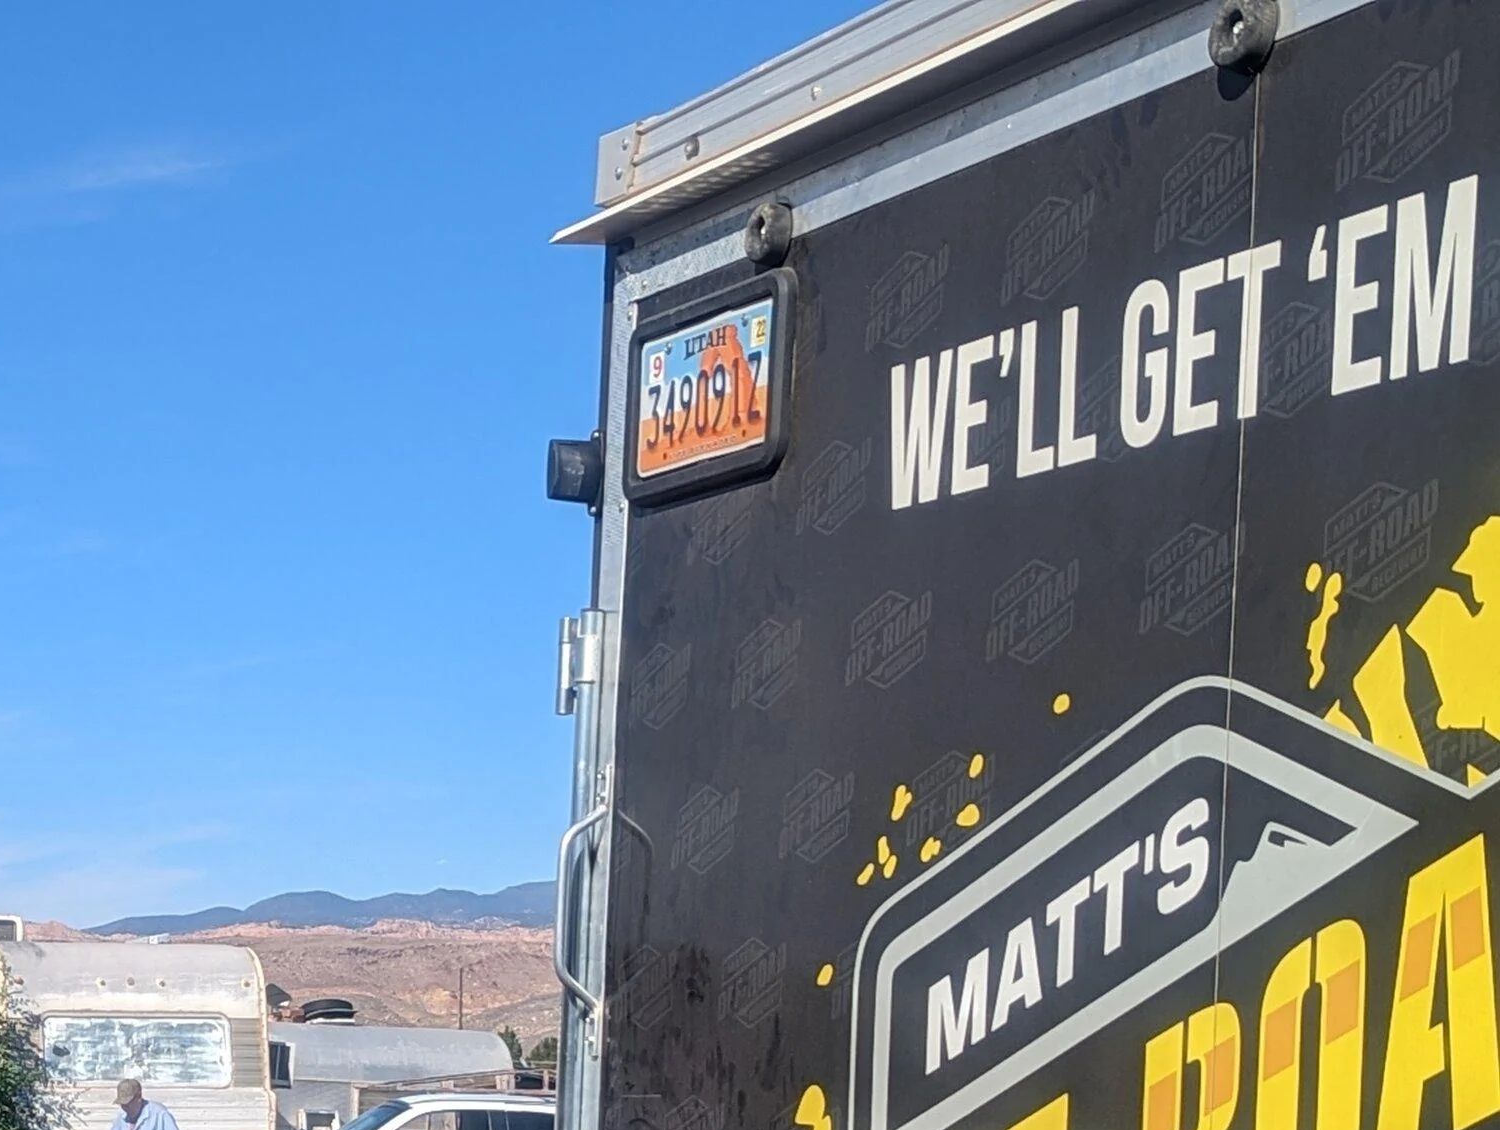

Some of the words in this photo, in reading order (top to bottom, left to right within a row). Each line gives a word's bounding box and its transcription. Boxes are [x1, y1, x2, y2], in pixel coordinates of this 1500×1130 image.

[1334, 48, 1461, 194] OFF-ROAD
[652, 355, 662, 379] 9
[684, 326, 727, 361] UTAH
[890, 305, 1097, 511] WE'LL
[1118, 239, 1283, 449] GET
[1307, 173, 1480, 397] 'EM
[924, 797, 1210, 1076] MATT'S
